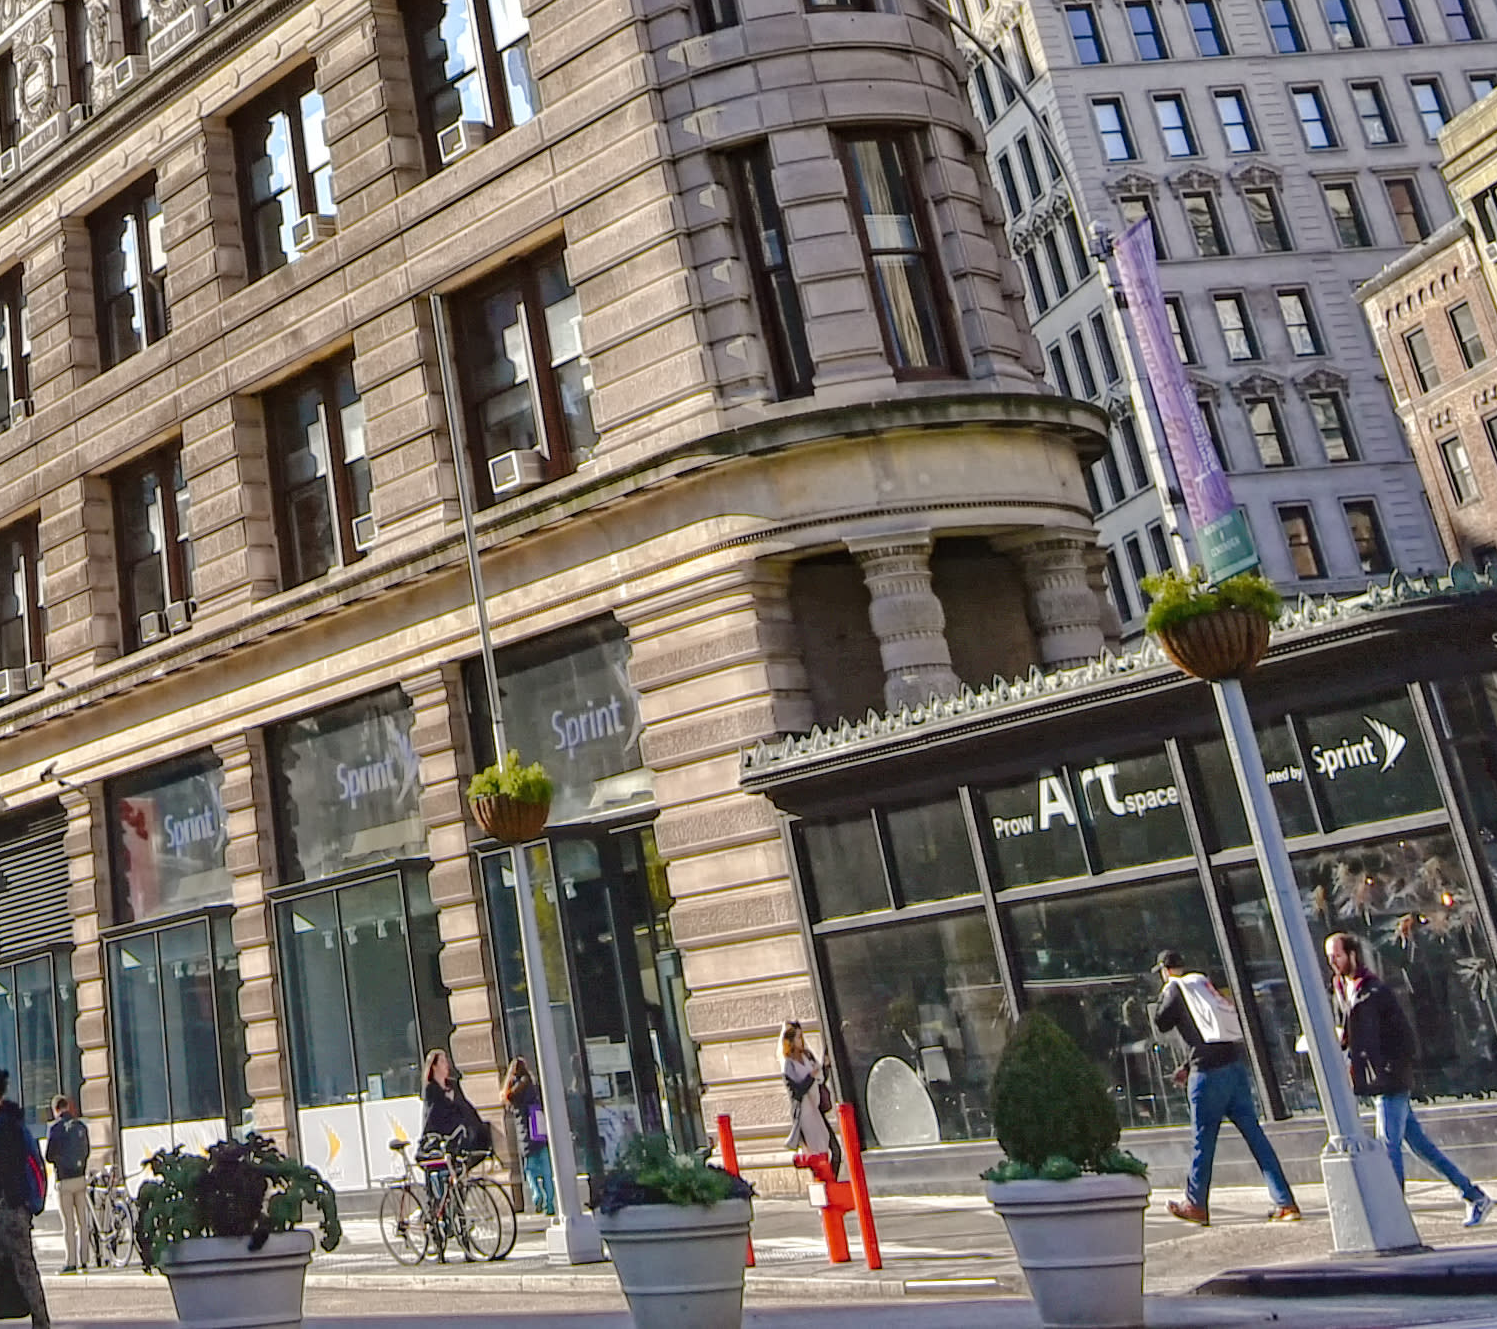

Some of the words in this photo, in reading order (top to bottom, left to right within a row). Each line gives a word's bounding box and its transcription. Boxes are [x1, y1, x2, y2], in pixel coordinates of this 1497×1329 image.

[552, 694, 625, 759] Sprint
[337, 756, 398, 809] Sprint
[1311, 737, 1378, 779] Sprint
[993, 813, 1033, 840] Prow
[1038, 762, 1125, 831] Art
[1124, 784, 1179, 818] space
[1290, 765, 1303, 781] by
[165, 805, 215, 858] Sprint
